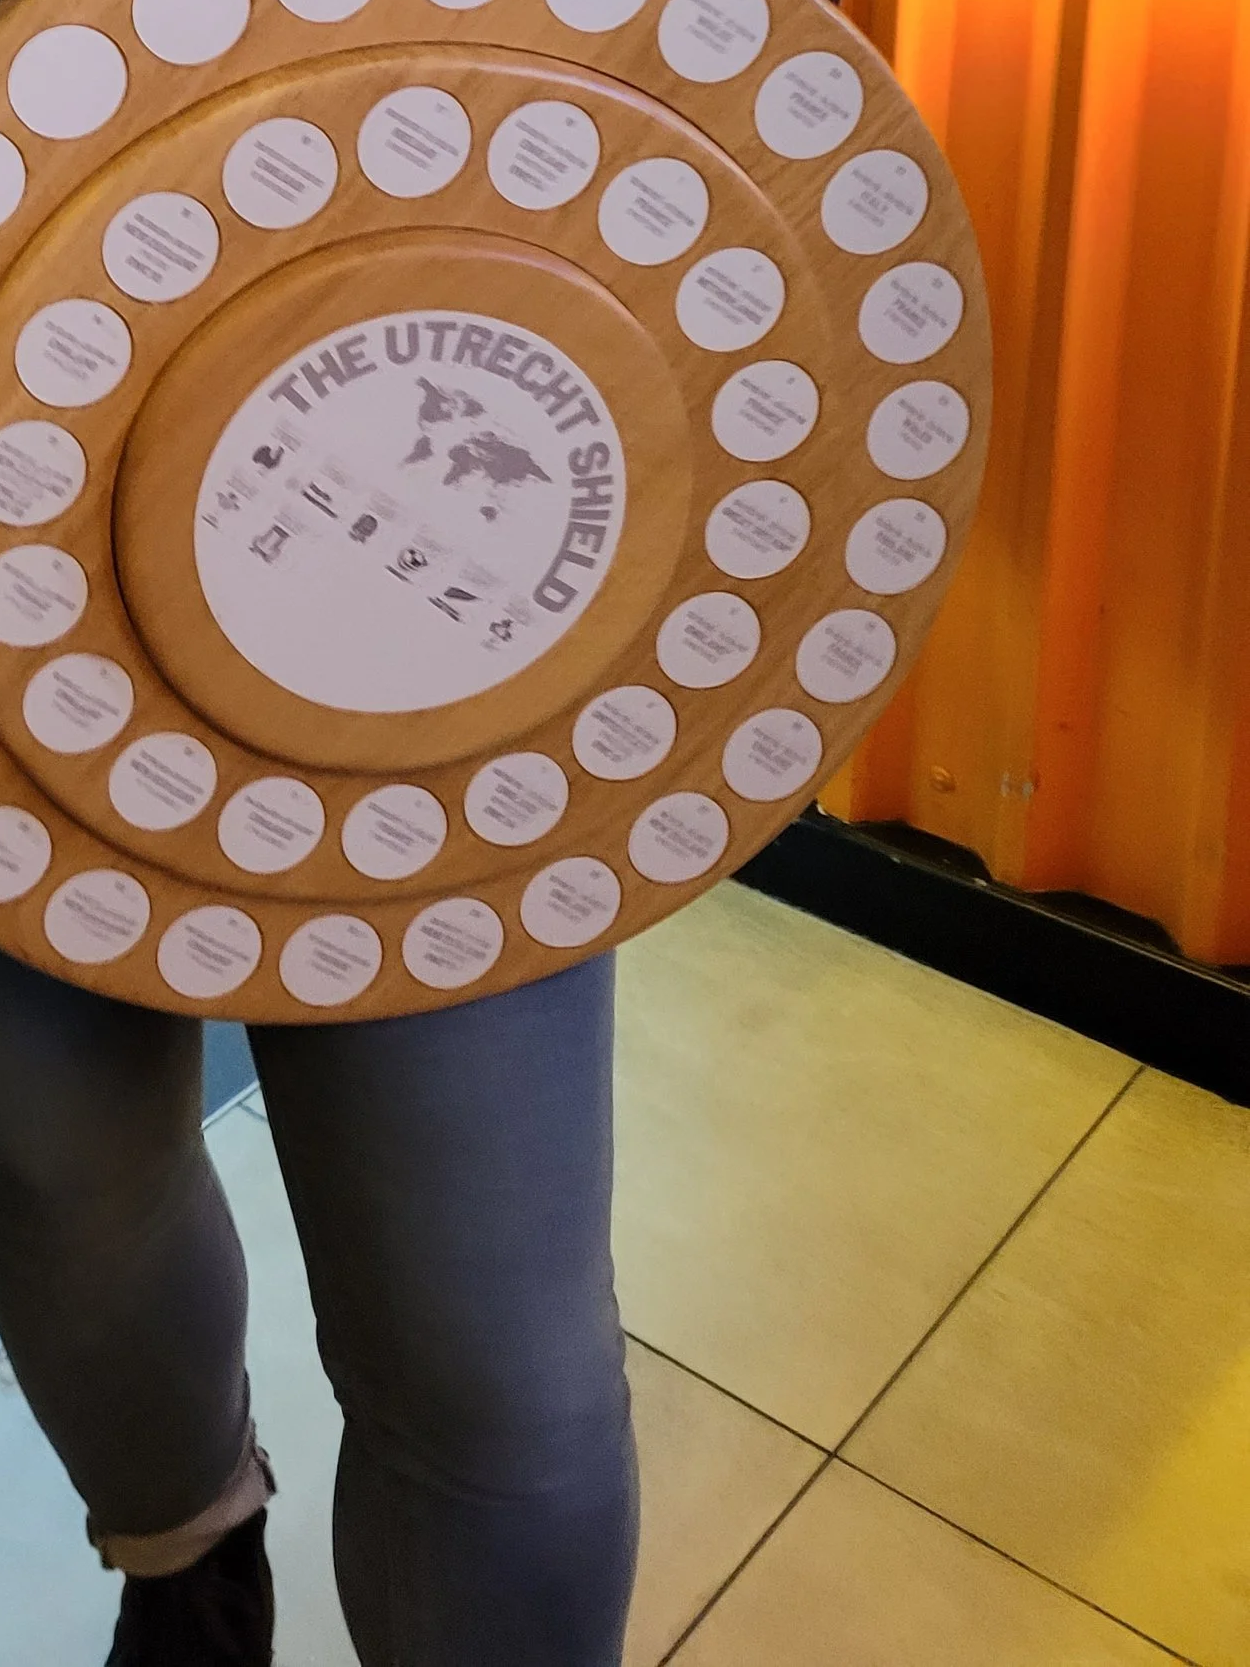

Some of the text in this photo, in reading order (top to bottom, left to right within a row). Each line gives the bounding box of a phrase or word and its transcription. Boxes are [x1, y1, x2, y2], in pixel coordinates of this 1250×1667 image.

[268, 333, 377, 414] THE
[384, 320, 600, 433] UTRECHT
[532, 440, 615, 614] SHIELD
